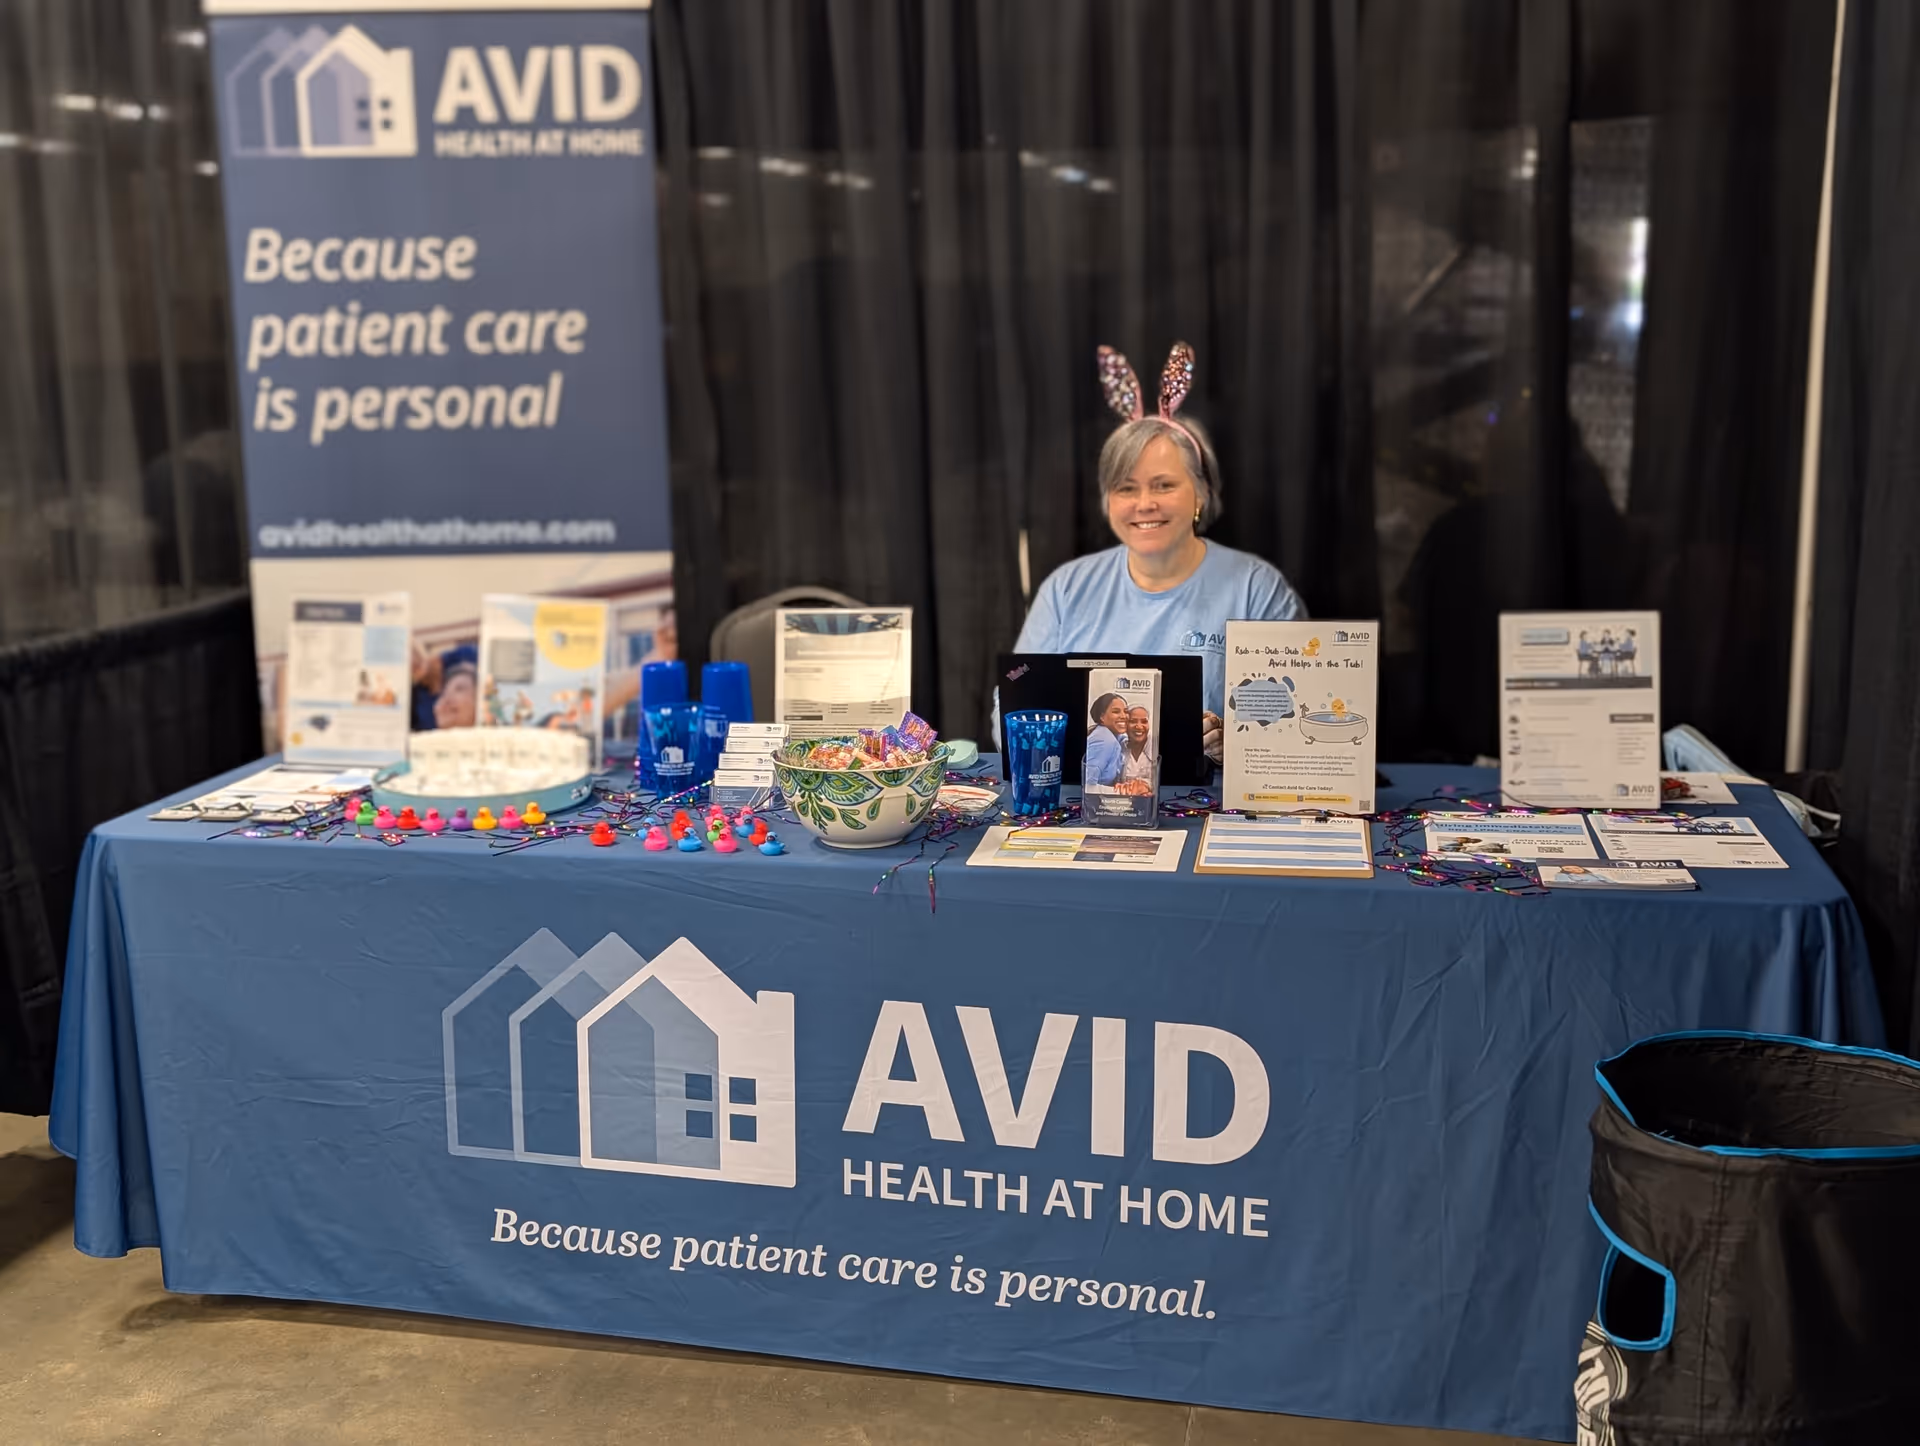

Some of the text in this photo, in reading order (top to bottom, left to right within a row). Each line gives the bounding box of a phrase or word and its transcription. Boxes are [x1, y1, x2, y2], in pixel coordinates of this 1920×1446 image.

[433, 44, 643, 123] AVID
[434, 128, 644, 157] HEALTH AT HOME
[244, 228, 477, 283] Because
[247, 301, 588, 372] patient care
[253, 371, 564, 446] is personal
[258, 519, 617, 548] avidhealthathome.com
[1350, 632, 1370, 640] AVID
[1131, 679, 1151, 687] AVID
[1268, 658, 1364, 670] Avid Helps in the Tub!
[1631, 785, 1655, 793] AVID
[841, 1000, 1271, 1165] AVID
[843, 1157, 1269, 1238] HEALTH AT HOME
[490, 1207, 1217, 1320] Because patient care is personal.
